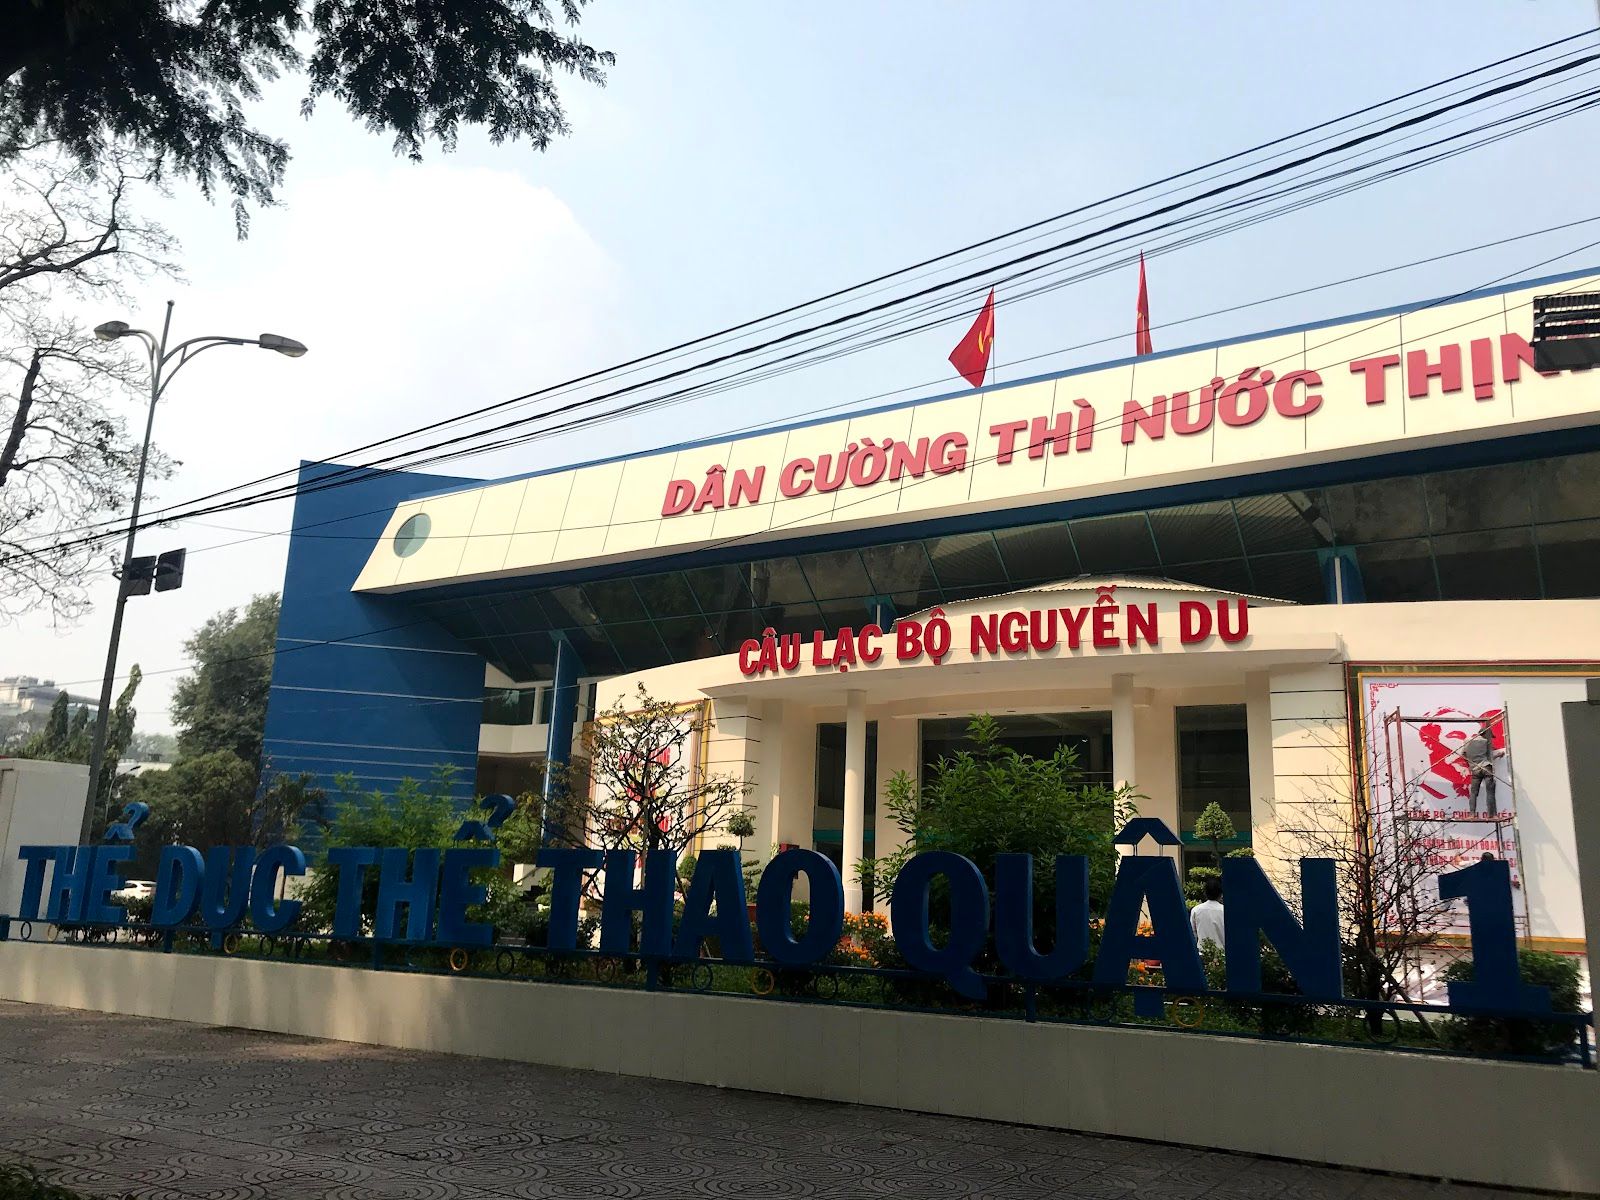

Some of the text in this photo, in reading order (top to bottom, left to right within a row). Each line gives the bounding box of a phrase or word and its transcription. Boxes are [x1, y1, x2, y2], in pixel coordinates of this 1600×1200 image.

[661, 464, 766, 517] DÂN
[779, 432, 968, 498] CƯỜNG
[989, 398, 1096, 465] THÌ
[1121, 366, 1324, 445] NƯỚC
[739, 584, 1249, 675] CÂU LẠC BỘ NGUYỄN DU
[18, 793, 1551, 1017] THỂ DỤC THỂ THAO QUẬN 1
